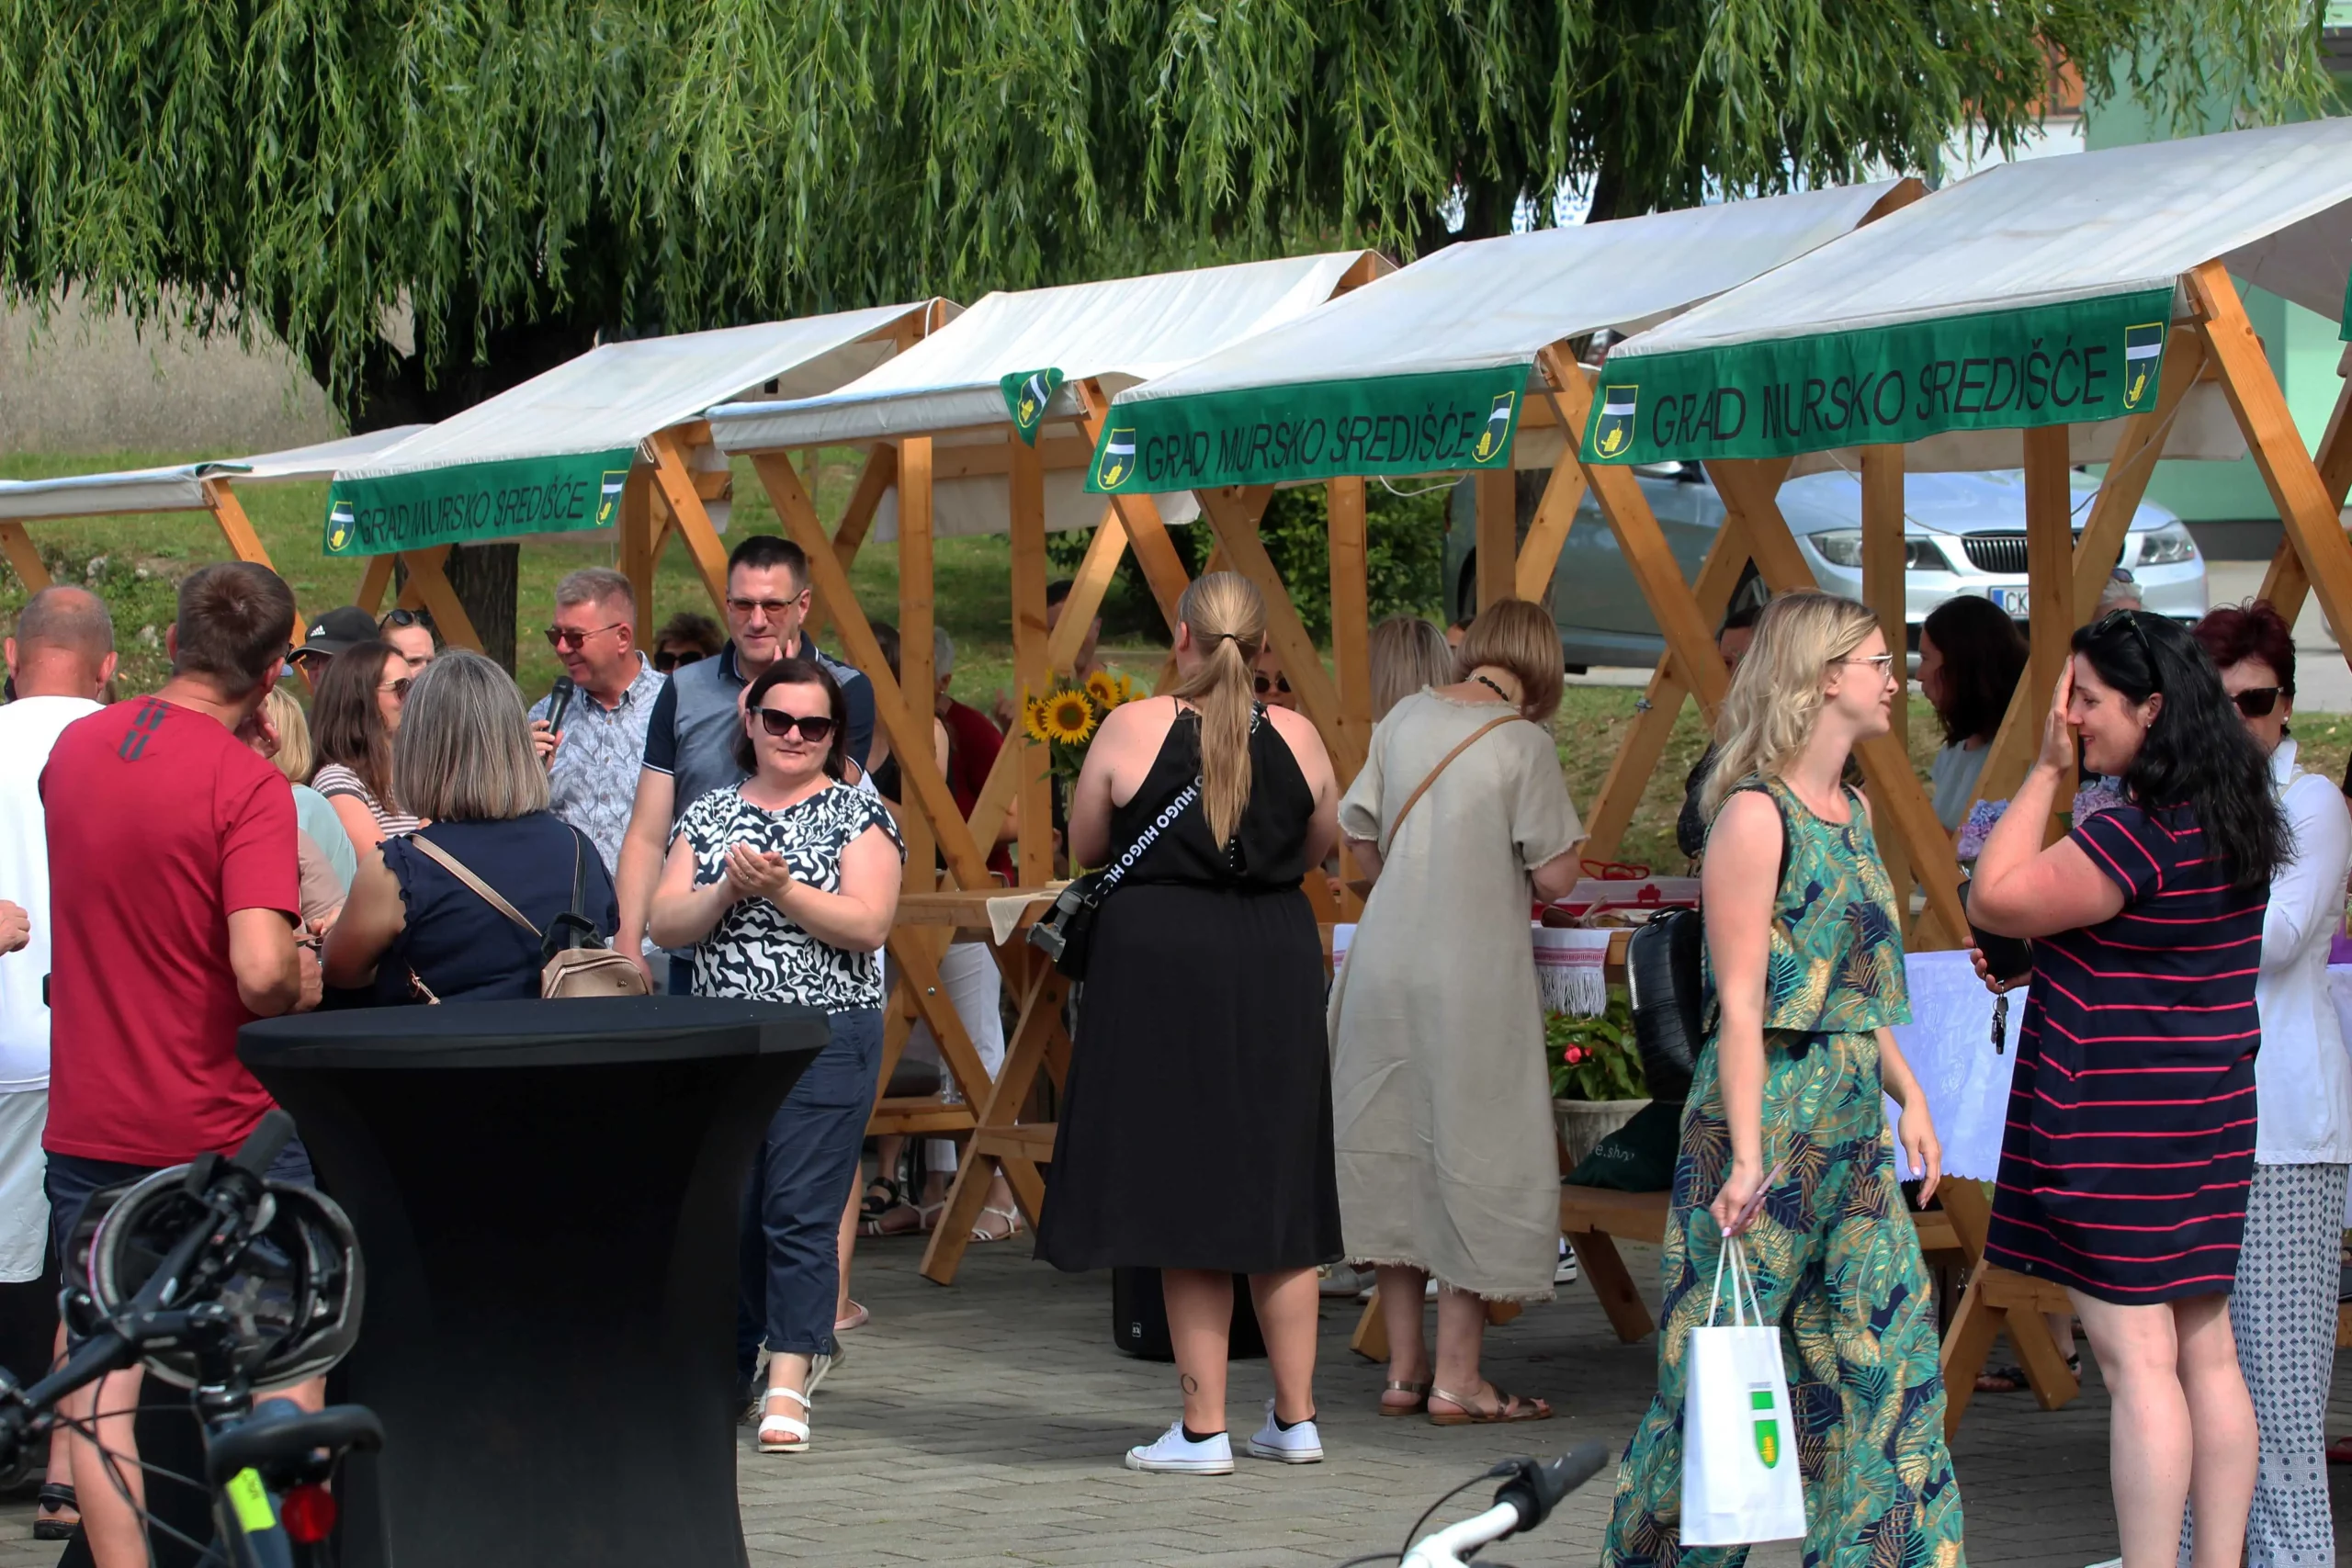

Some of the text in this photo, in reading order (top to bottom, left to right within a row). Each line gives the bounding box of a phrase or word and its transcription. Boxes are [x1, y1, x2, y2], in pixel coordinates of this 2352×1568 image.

[1652, 387, 1747, 448] GRAD
[1916, 334, 2108, 421] SREDIŠĆE
[1145, 401, 1476, 482] GRAD MURSKO SREDIŠĆE
[359, 474, 589, 545] GRAD MURSKO SREDIŠĆE
[2006, 591, 2029, 614] CK
[1156, 785, 1198, 829] HUGO
[1121, 825, 1159, 866] HUGO
